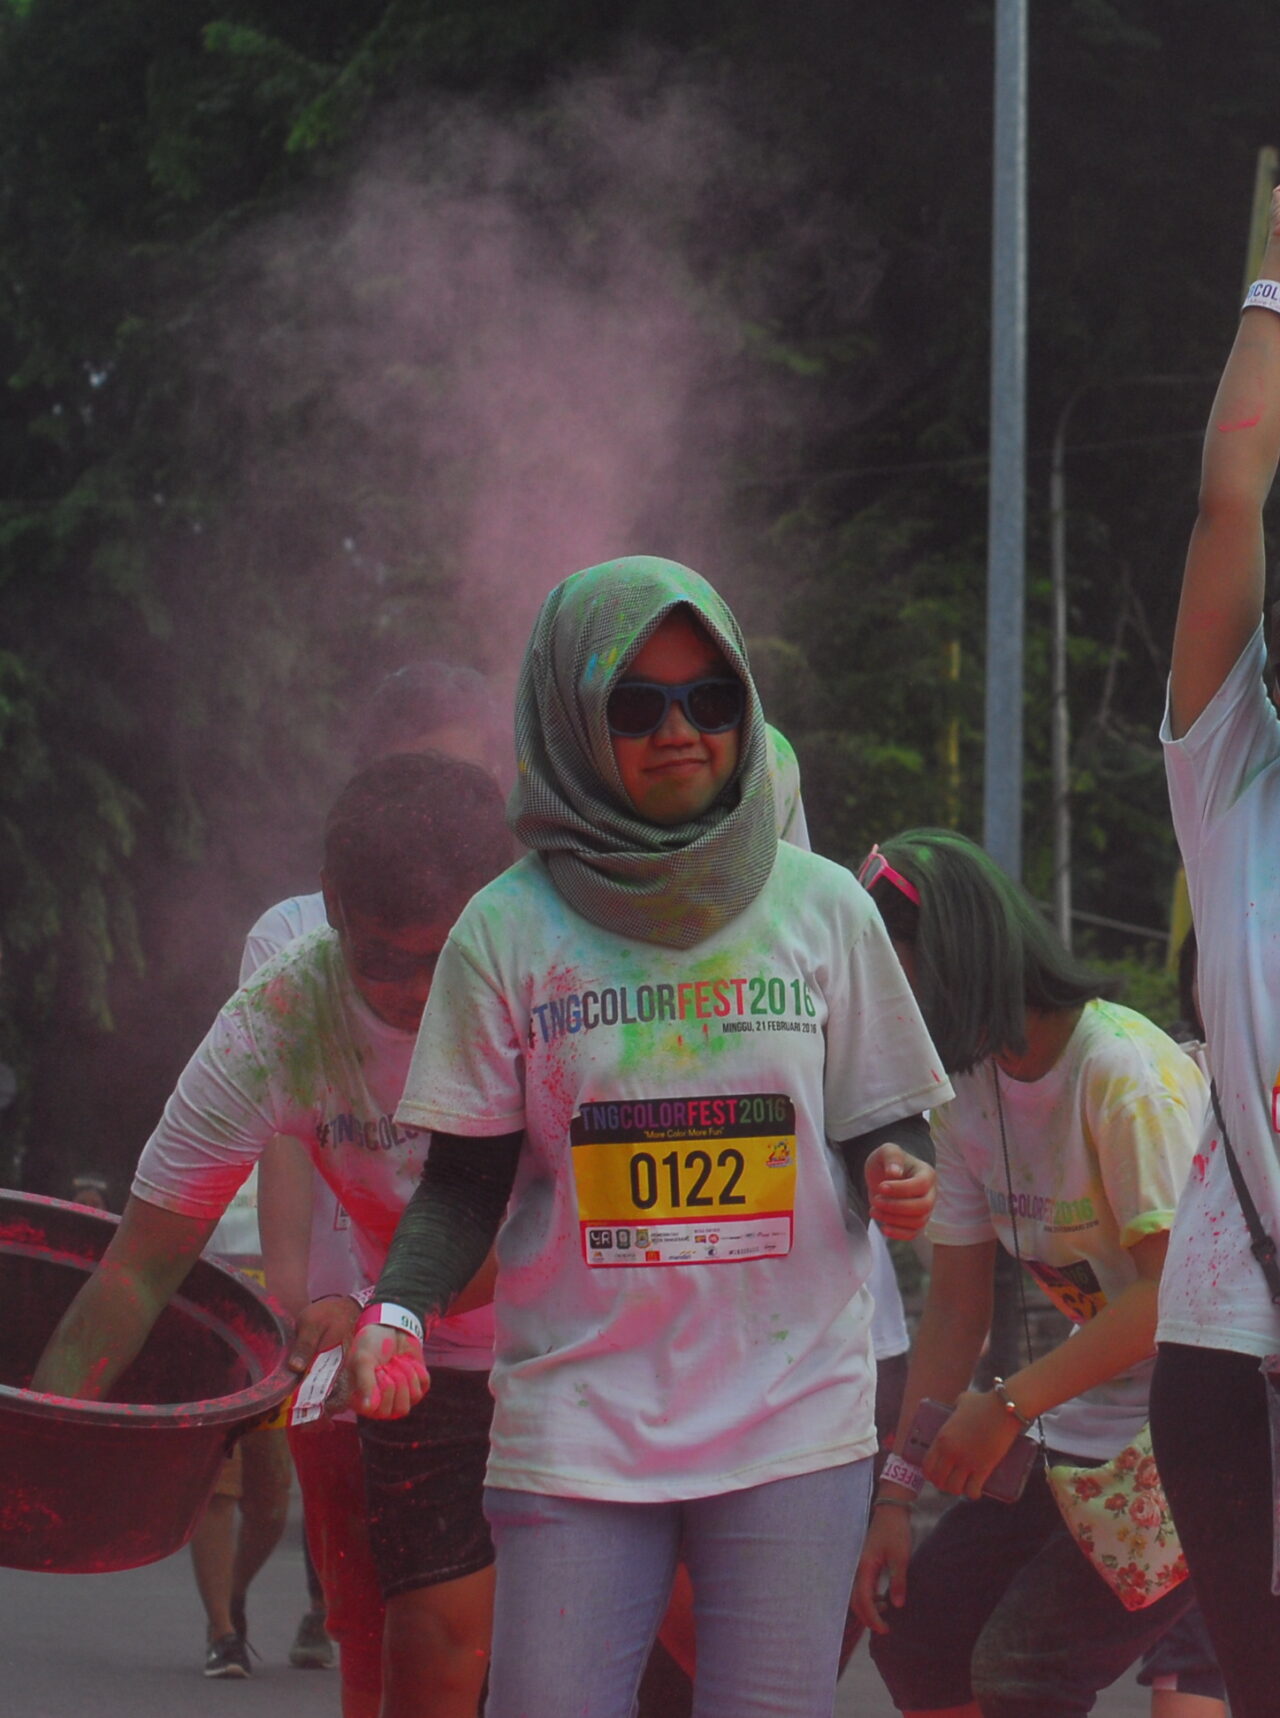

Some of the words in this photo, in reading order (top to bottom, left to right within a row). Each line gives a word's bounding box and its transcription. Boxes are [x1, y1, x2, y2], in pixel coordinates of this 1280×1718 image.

[756, 1020, 766, 1032] 21
[767, 1021, 801, 1032] FEBRUARI
[801, 1023, 817, 1034] 2016
[580, 1097, 786, 1131] TNGCOLORFEST2016
[629, 1147, 747, 1210] 0122
